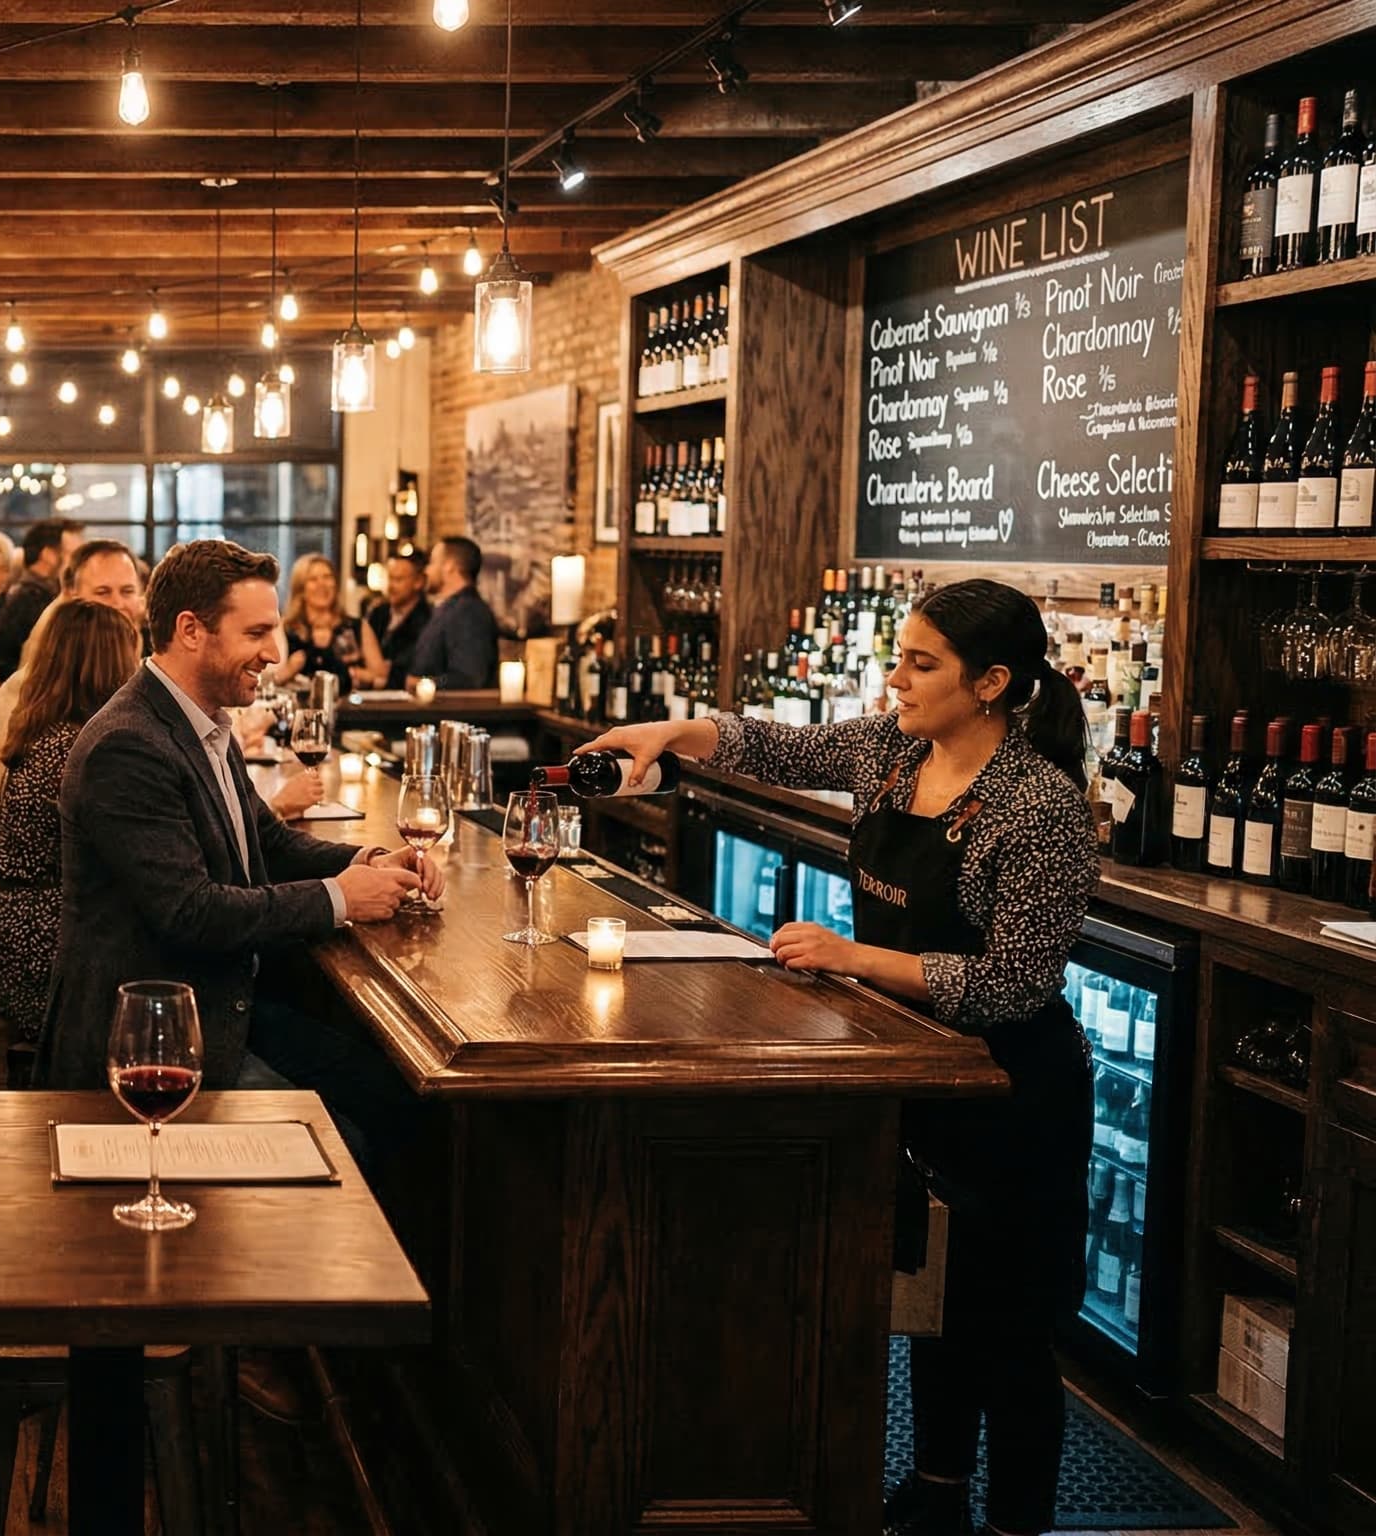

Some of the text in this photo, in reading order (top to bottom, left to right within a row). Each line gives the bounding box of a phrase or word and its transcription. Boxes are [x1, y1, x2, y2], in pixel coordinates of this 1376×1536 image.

[955, 192, 1114, 281] WINE LIST
[1045, 271, 1094, 317] Pinot
[1100, 263, 1144, 305] Noir
[870, 308, 932, 351] Cabernet
[934, 303, 1009, 343] Sauvignon
[1042, 315, 1156, 360] Chardonnay
[870, 352, 906, 389] Pinot
[909, 349, 940, 382] Noir
[1042, 364, 1088, 404] Rose
[868, 389, 949, 429] Chardonnay
[868, 428, 902, 462] Rose
[946, 463, 994, 504] Board
[1036, 459, 1101, 500] Cheese
